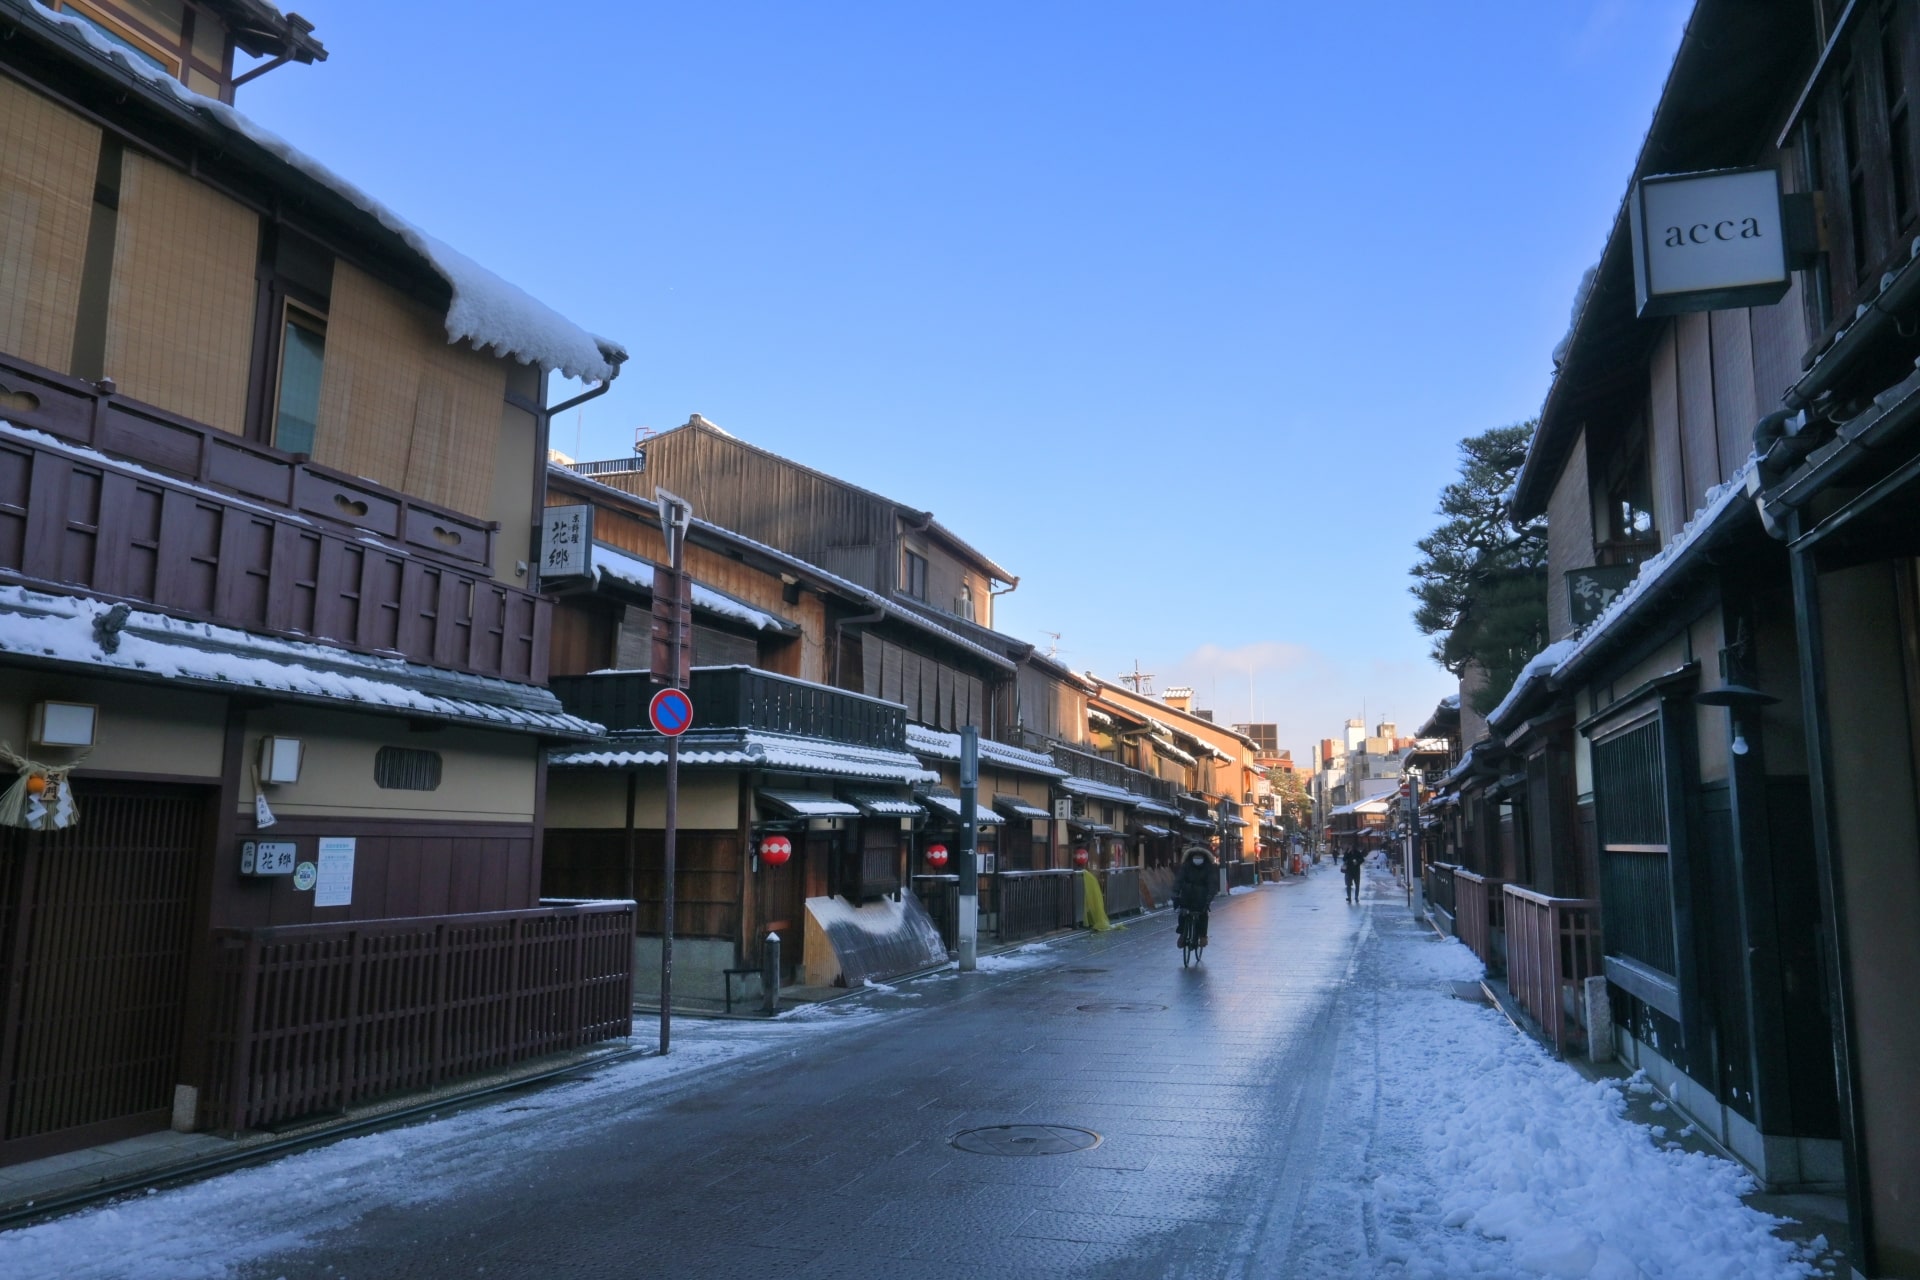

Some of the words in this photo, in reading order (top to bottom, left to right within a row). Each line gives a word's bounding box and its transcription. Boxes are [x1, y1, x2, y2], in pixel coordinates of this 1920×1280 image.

[1665, 216, 1763, 248] acca
[571, 513, 580, 544] 京料理
